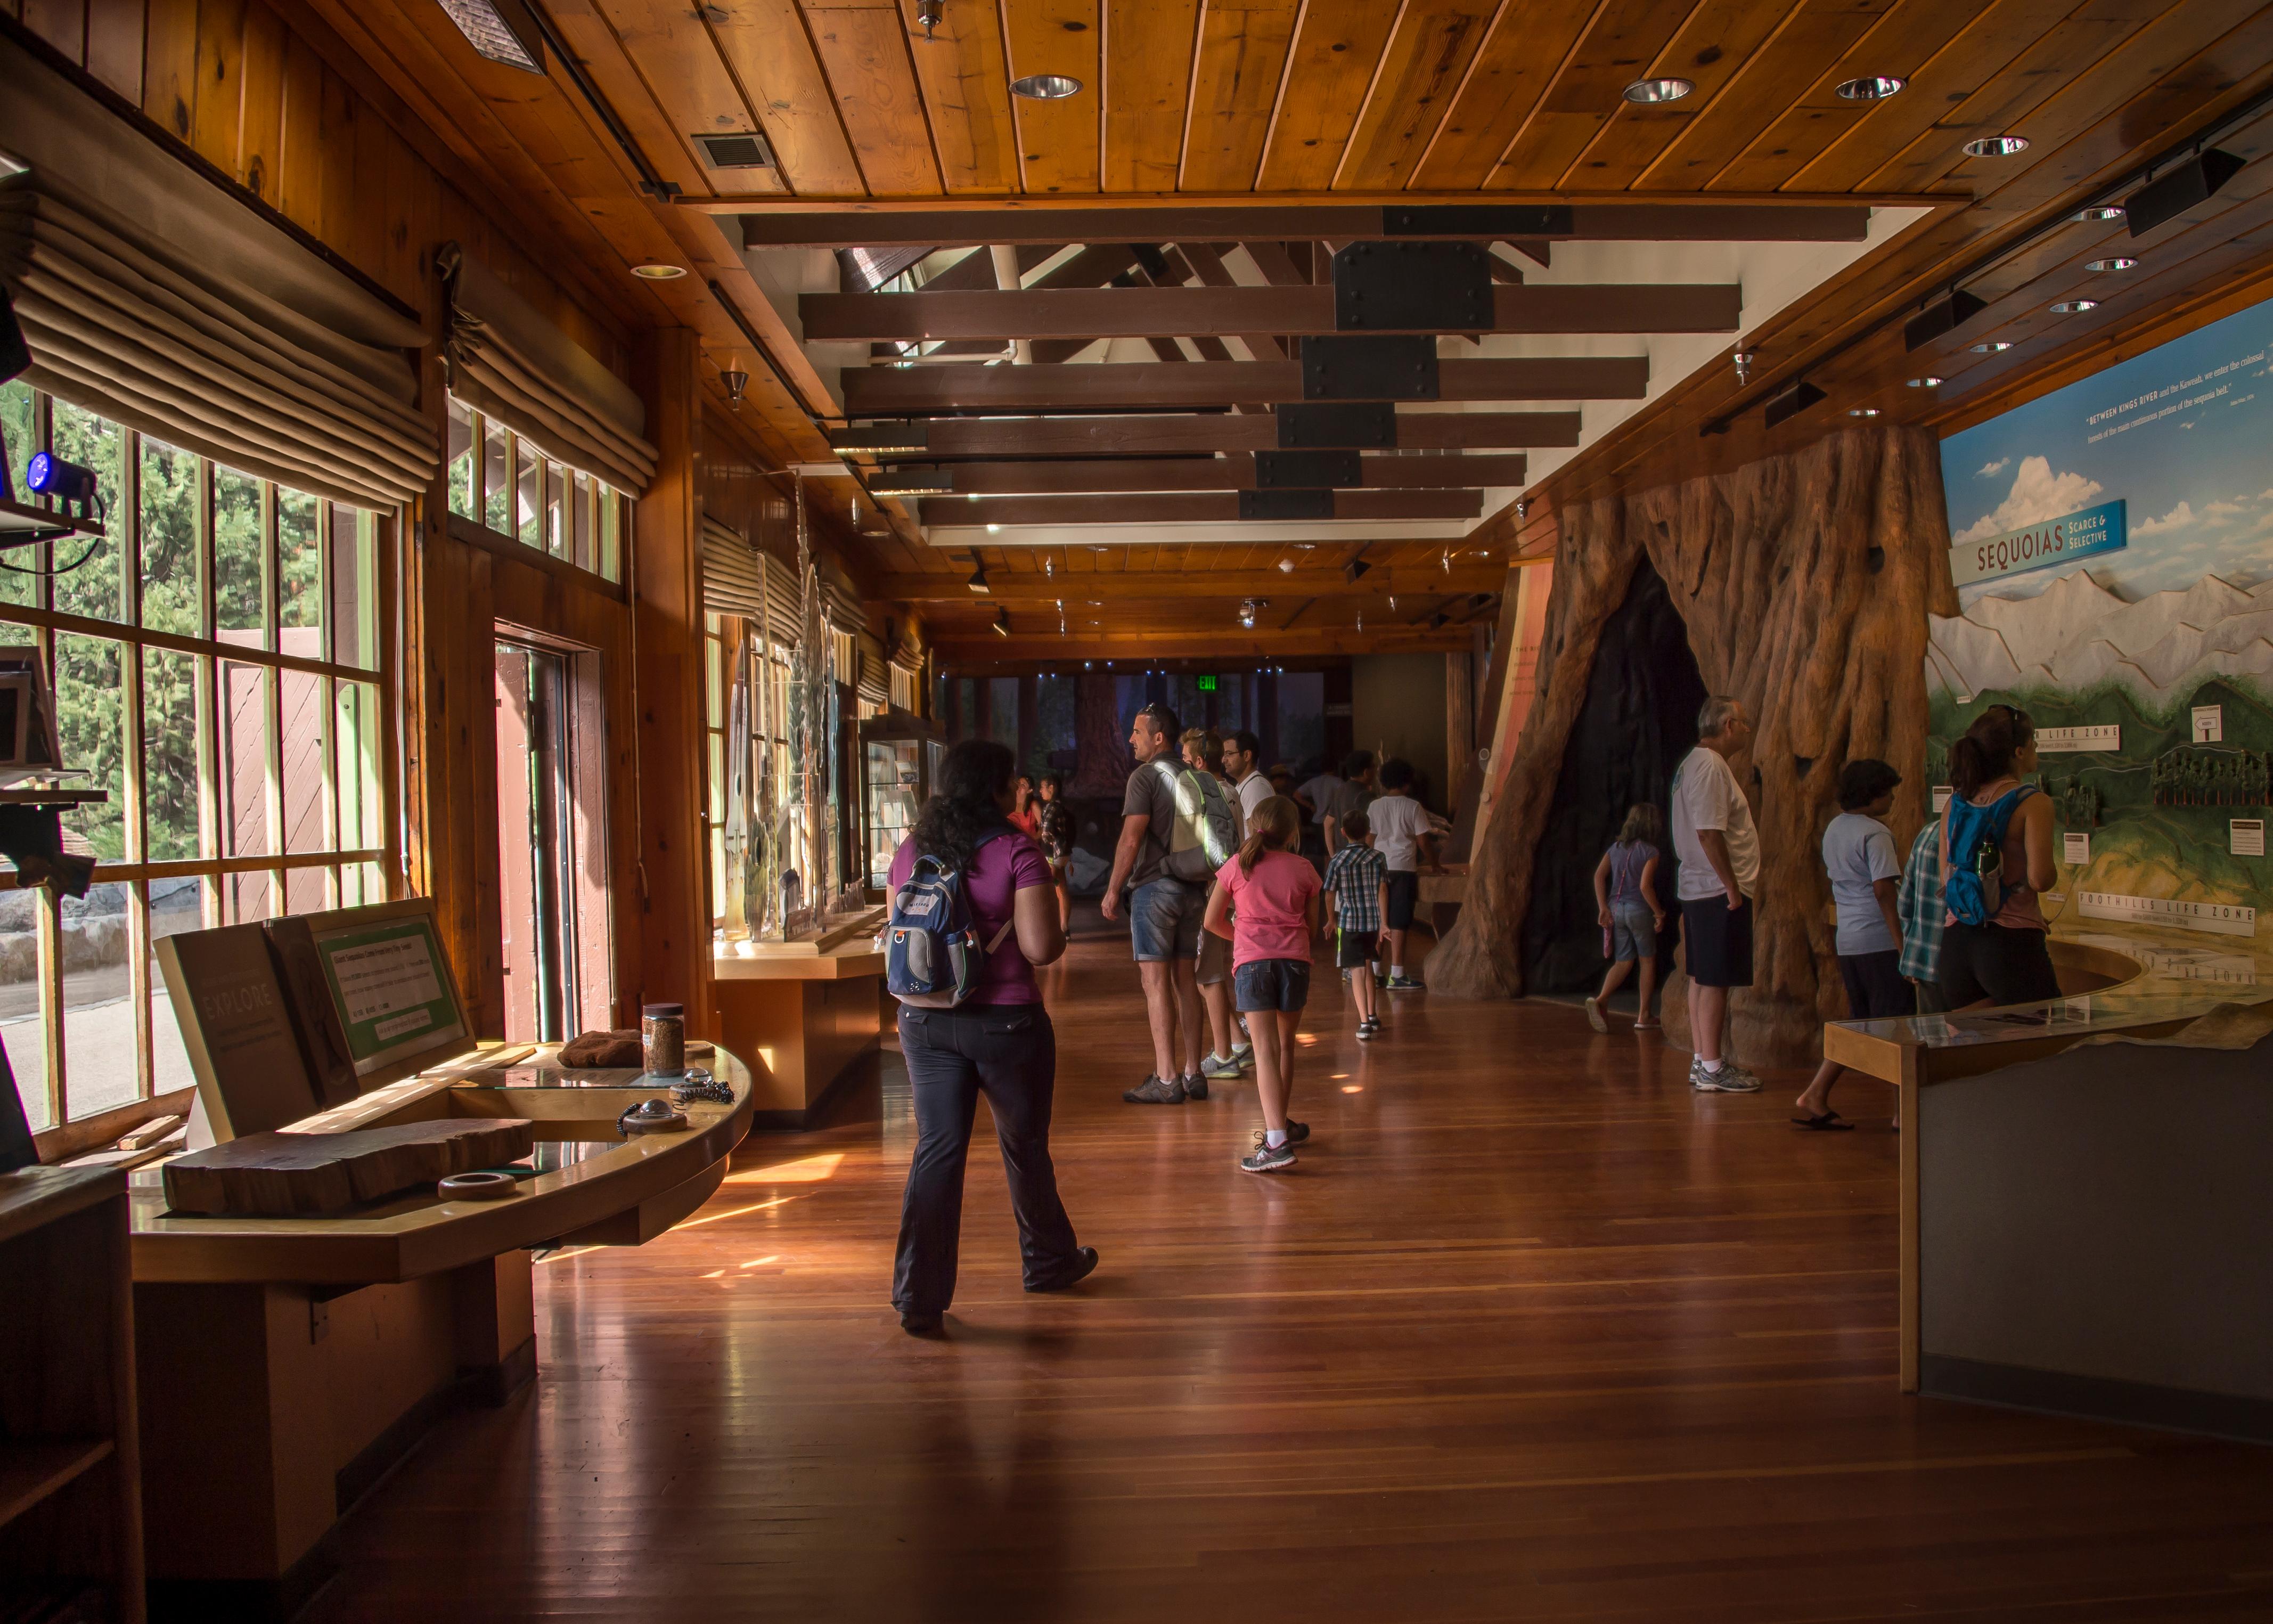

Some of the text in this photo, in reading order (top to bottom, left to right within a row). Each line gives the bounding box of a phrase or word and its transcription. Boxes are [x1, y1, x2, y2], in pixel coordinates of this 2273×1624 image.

[2119, 399, 2138, 413] KINGS
[2139, 390, 2157, 405] RIVER
[2159, 387, 2169, 398] and
[2170, 384, 2179, 395] the
[2204, 371, 2213, 380] we
[2214, 365, 2229, 377] enter
[2230, 361, 2239, 371] the
[2241, 350, 2264, 366] colossal
[2158, 405, 2177, 420] portion
[2177, 401, 2184, 411] of
[2184, 398, 2193, 408] the
[2194, 390, 2215, 405] sequoia
[2068, 515, 2106, 534] SCARCE &
[1977, 524, 2064, 572] SEQUOIAS
[2069, 530, 2107, 550] SELECTIVE
[1199, 676, 1216, 690] EXIT
[2049, 729, 2074, 739] LIFE
[2086, 727, 2117, 737] ZONE
[2080, 893, 2252, 920] FOOTHILLS LIFE ZONE
[203, 983, 273, 1020] EXPLORE
